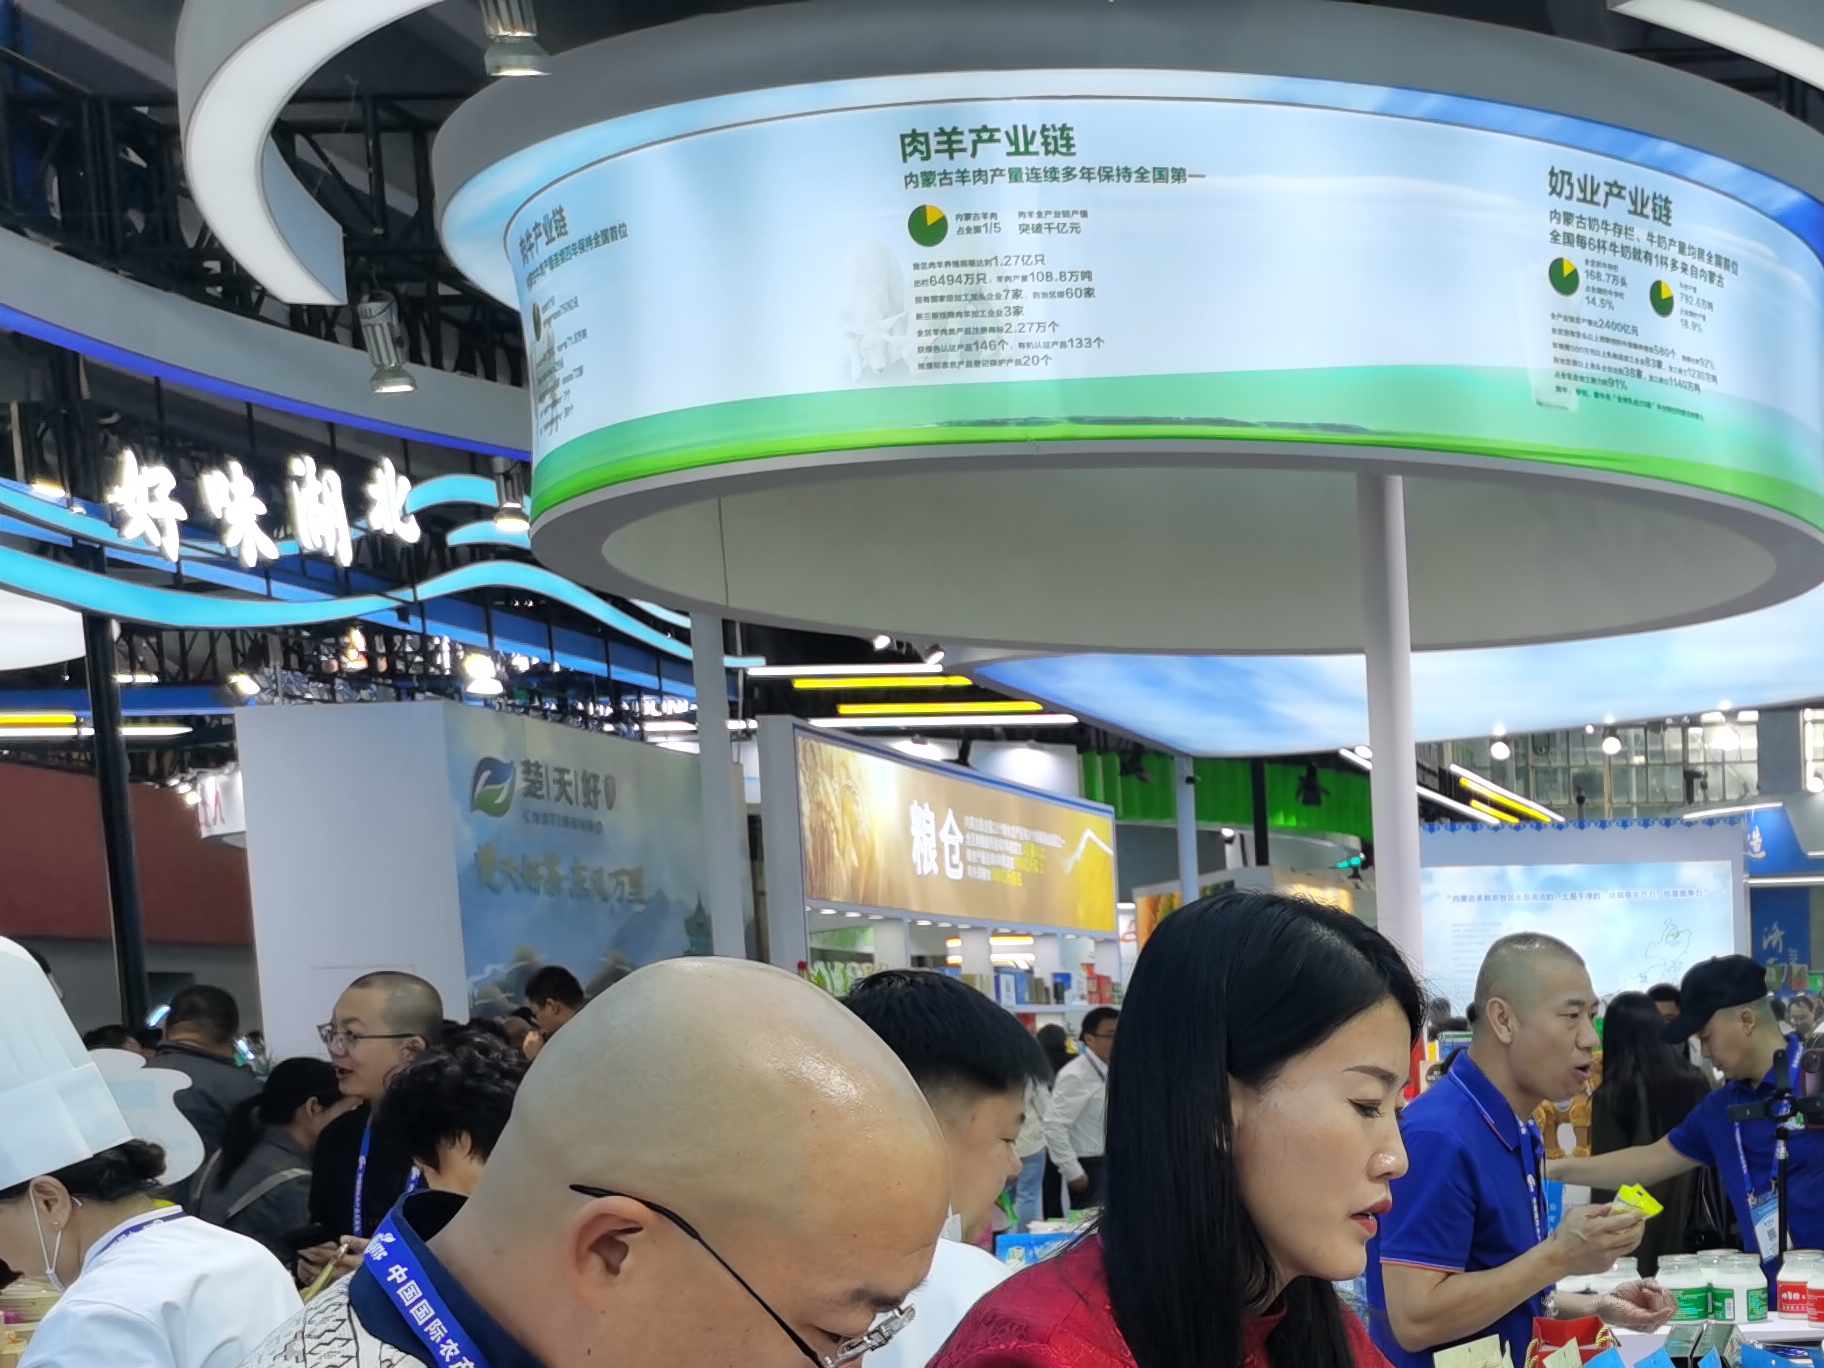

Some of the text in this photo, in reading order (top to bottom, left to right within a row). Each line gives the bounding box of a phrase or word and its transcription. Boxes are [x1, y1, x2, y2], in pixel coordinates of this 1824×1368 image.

[900, 123, 1077, 163] 肉羊产业链
[904, 165, 1206, 189] 内蒙古羊肉产量连续多年保持全国第一
[1548, 165, 1673, 227] 奶业产业链
[957, 222, 1001, 235] 占全国1/5
[1018, 222, 1081, 234] 突破千亿元
[105, 448, 422, 568] 好味湖北
[911, 800, 965, 880] 粮仓
